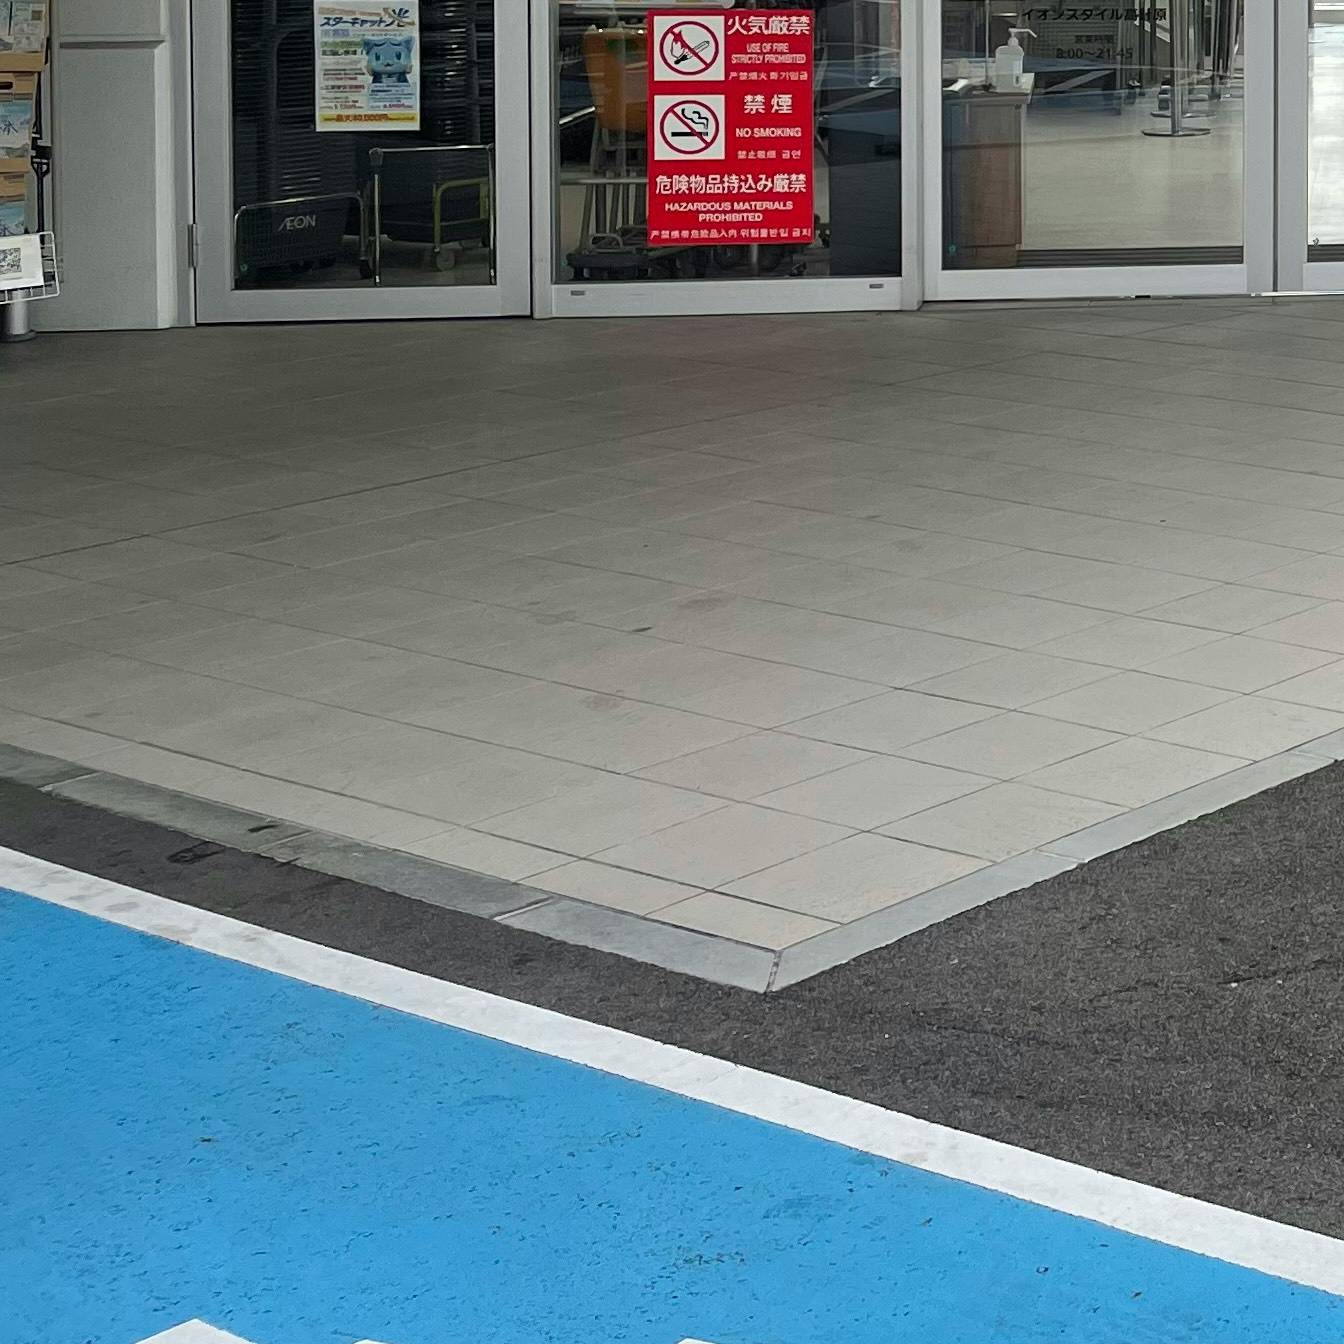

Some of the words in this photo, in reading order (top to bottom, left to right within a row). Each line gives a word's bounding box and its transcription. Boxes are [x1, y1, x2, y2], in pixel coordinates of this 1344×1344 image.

[727, 16, 810, 36] 火気厳禁
[746, 43, 761, 53] USE
[762, 43, 772, 53] OF
[744, 94, 793, 115] 禁煙
[735, 128, 752, 138] NO
[754, 128, 802, 138] SMOKING
[655, 174, 807, 194] 危険物品持込み厳禁
[665, 202, 732, 211] HAZARDOUS
[734, 201, 793, 210] MATERIALS
[698, 213, 763, 223] PROHIBITED
